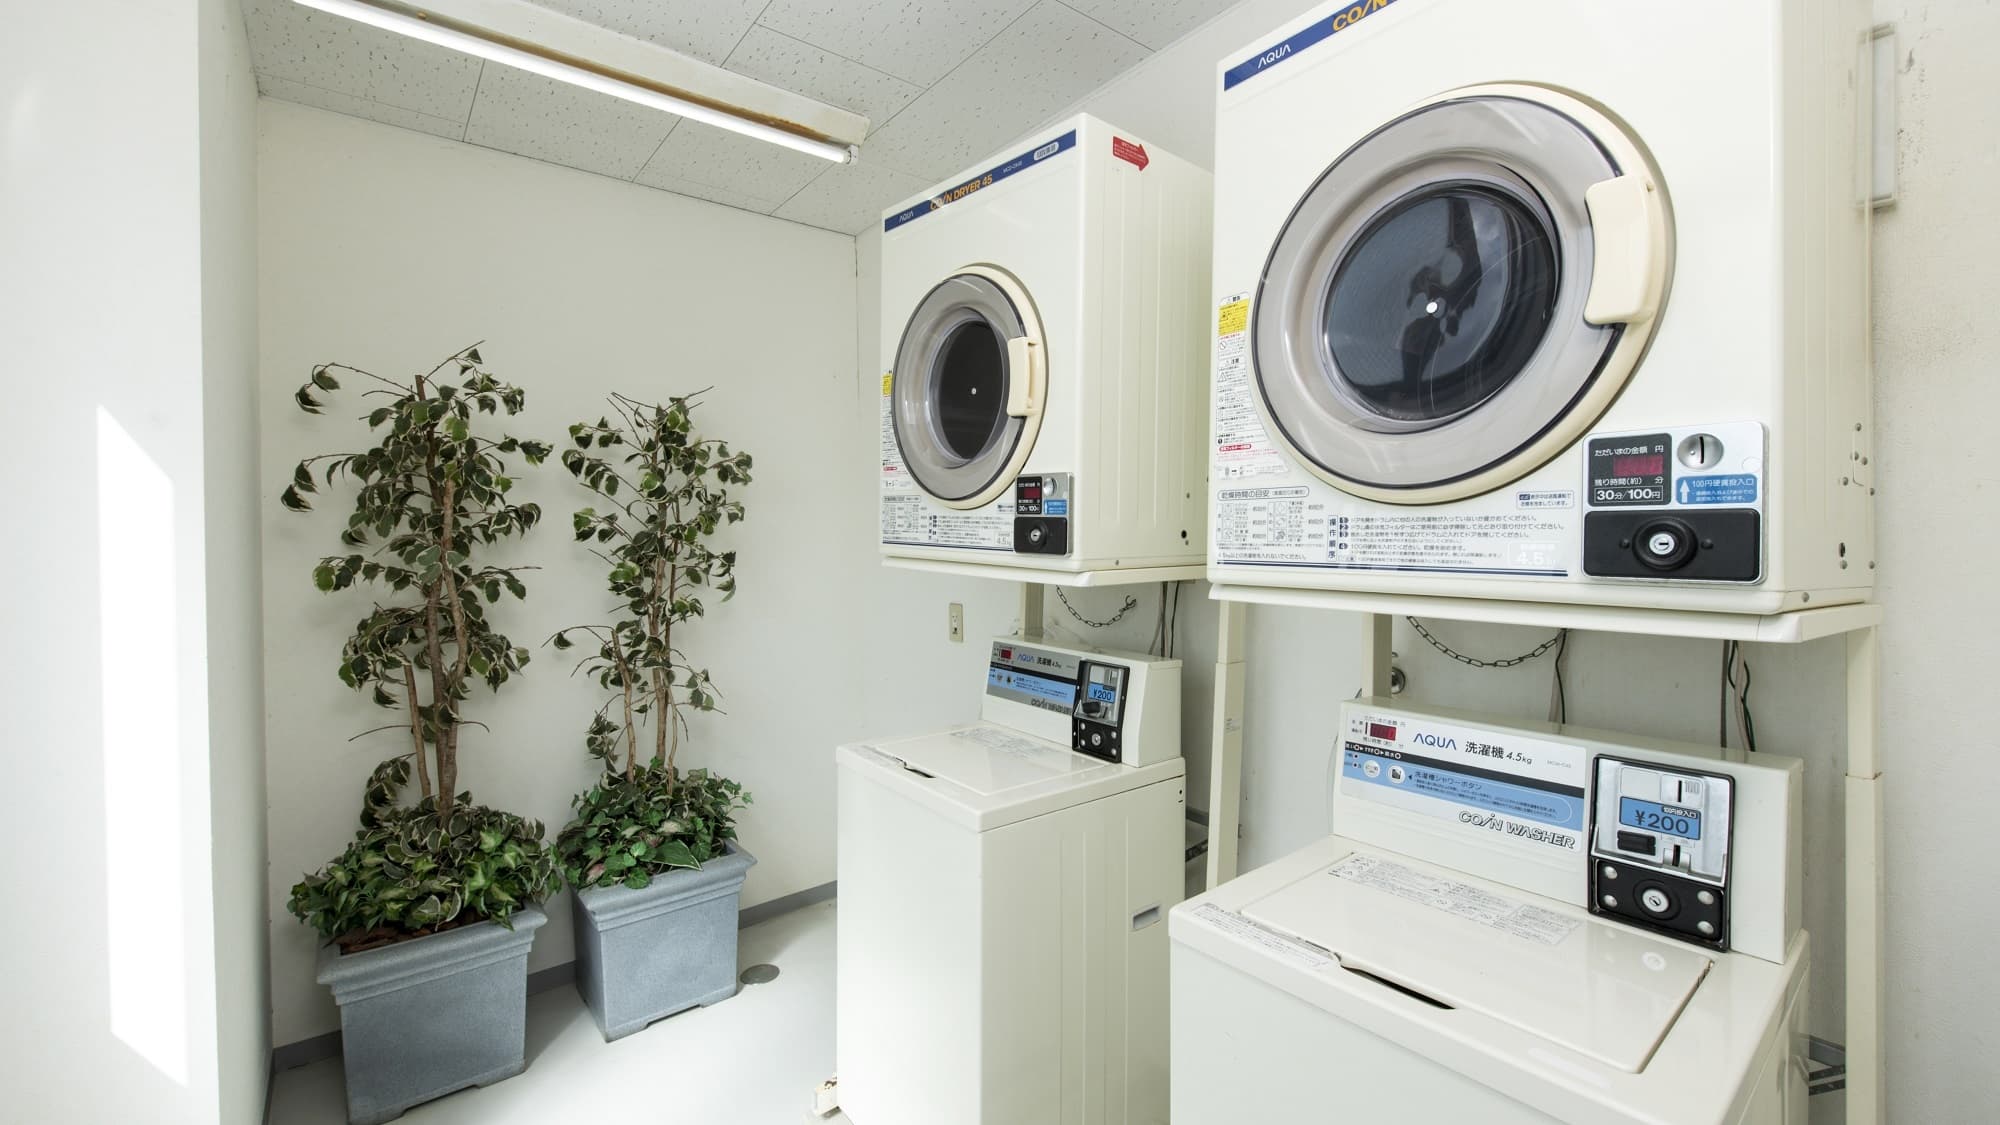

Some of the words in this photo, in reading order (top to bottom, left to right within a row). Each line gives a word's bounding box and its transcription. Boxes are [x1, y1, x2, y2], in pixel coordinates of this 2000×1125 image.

[1257, 44, 1291, 69] AQUA
[953, 179, 981, 201] DRYER
[981, 174, 993, 187] 45
[1413, 733, 1457, 751] AQUA
[1465, 740, 1504, 760] 洗濯機
[1506, 752, 1533, 765] 4.5kg
[1506, 822, 1576, 849] WASHER
[1635, 809, 1689, 835] ¥200
